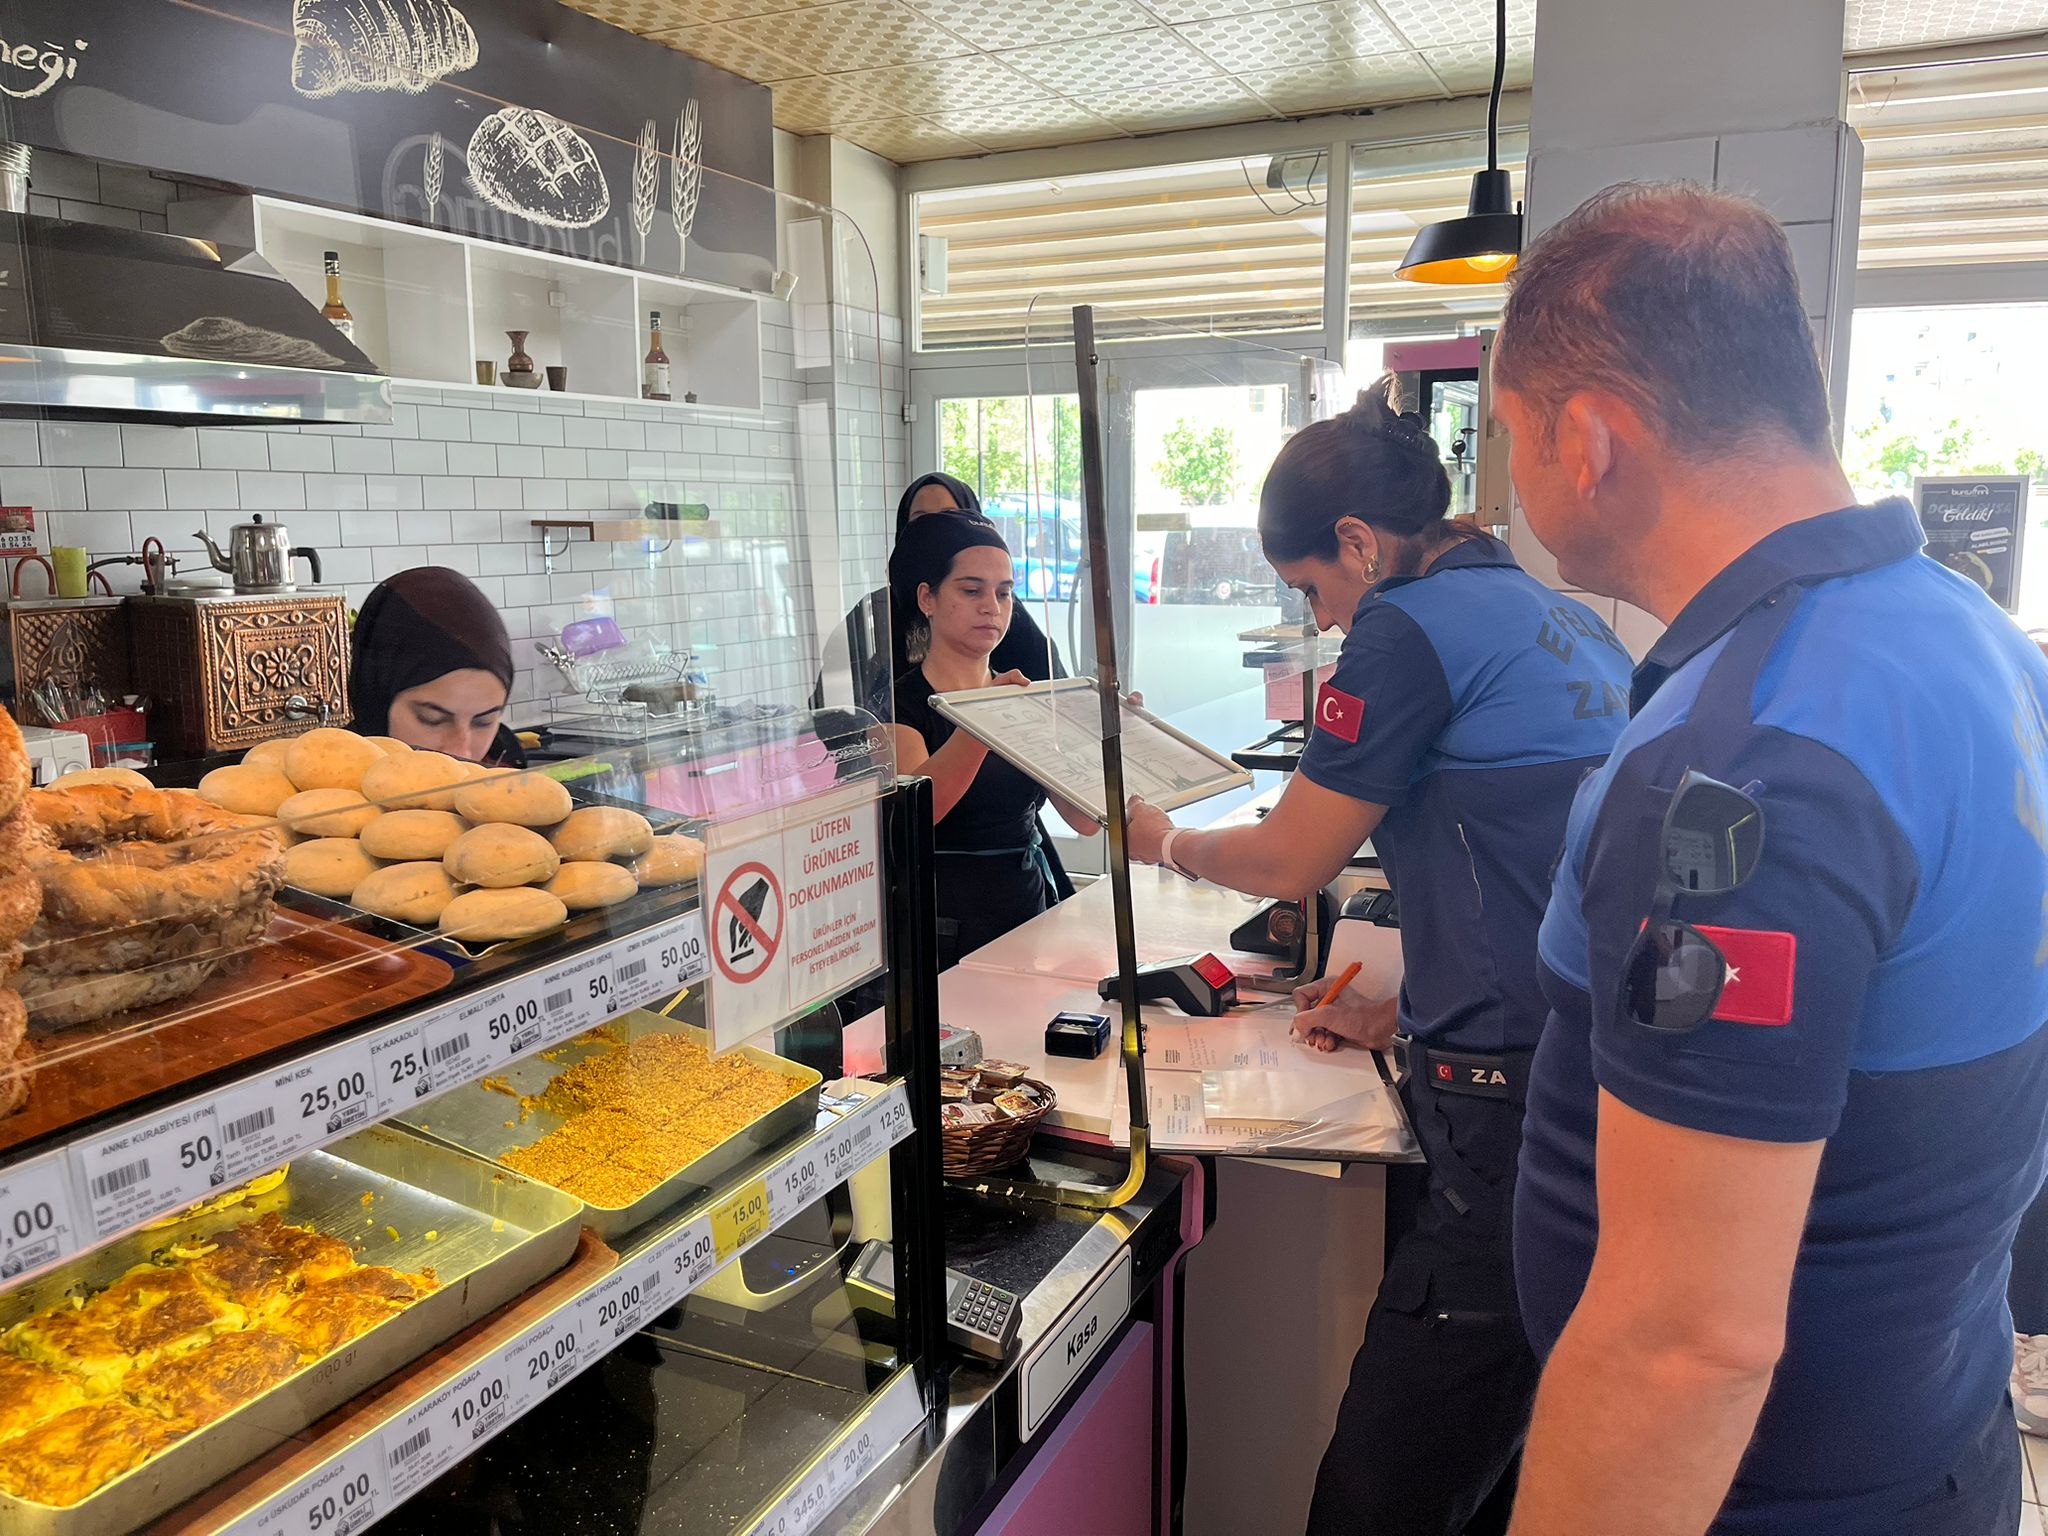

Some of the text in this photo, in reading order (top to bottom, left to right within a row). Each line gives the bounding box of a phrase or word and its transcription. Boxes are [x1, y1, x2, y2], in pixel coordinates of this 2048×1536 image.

[810, 816, 851, 843] LÜTFEN
[803, 840, 860, 874] ÜRÜNLERE
[789, 861, 875, 909] DOKUNMAYINIZ
[791, 919, 876, 967] PERSONELİMİZDEN YARDIM
[812, 912, 857, 940] ÜRÜNLER İÇİN
[661, 937, 700, 968] 50,00
[589, 975, 613, 998] 50,
[459, 1003, 484, 1020] ELMALI
[484, 993, 505, 1007] TURTA
[489, 999, 537, 1040] 50,00
[275, 1066, 313, 1087] MİNİ KEK
[390, 1047, 429, 1083] 25,
[1471, 1069, 1507, 1085] ZA
[300, 1072, 365, 1118] 25,00
[365, 1091, 375, 1099] TL
[101, 1138, 129, 1156] ANNE
[132, 1113, 191, 1145] KURABİYESİ
[880, 1102, 906, 1131] 12,50
[180, 1135, 221, 1168] 50,
[823, 1139, 851, 1168] 15,00
[785, 1160, 814, 1193] 15,00
[0, 1202, 70, 1249] ,00 TL
[732, 1195, 761, 1226] 15,00
[674, 1236, 710, 1274] 35,00
[600, 1275, 623, 1292] POĞAÇA
[599, 1285, 639, 1327] 20,00
[529, 1324, 555, 1346] POĞAÇA
[1067, 1315, 1097, 1365] Kasa
[528, 1333, 575, 1380] 20,00
[408, 1371, 481, 1426] A1 KARAKÖY POĞAÇA
[451, 1379, 503, 1428] 10,00
[843, 1433, 870, 1472] 20,00
[270, 1488, 310, 1519] ÜSKÜDAR
[312, 1464, 345, 1491] POĞAÇA
[309, 1473, 369, 1531] 50,00
